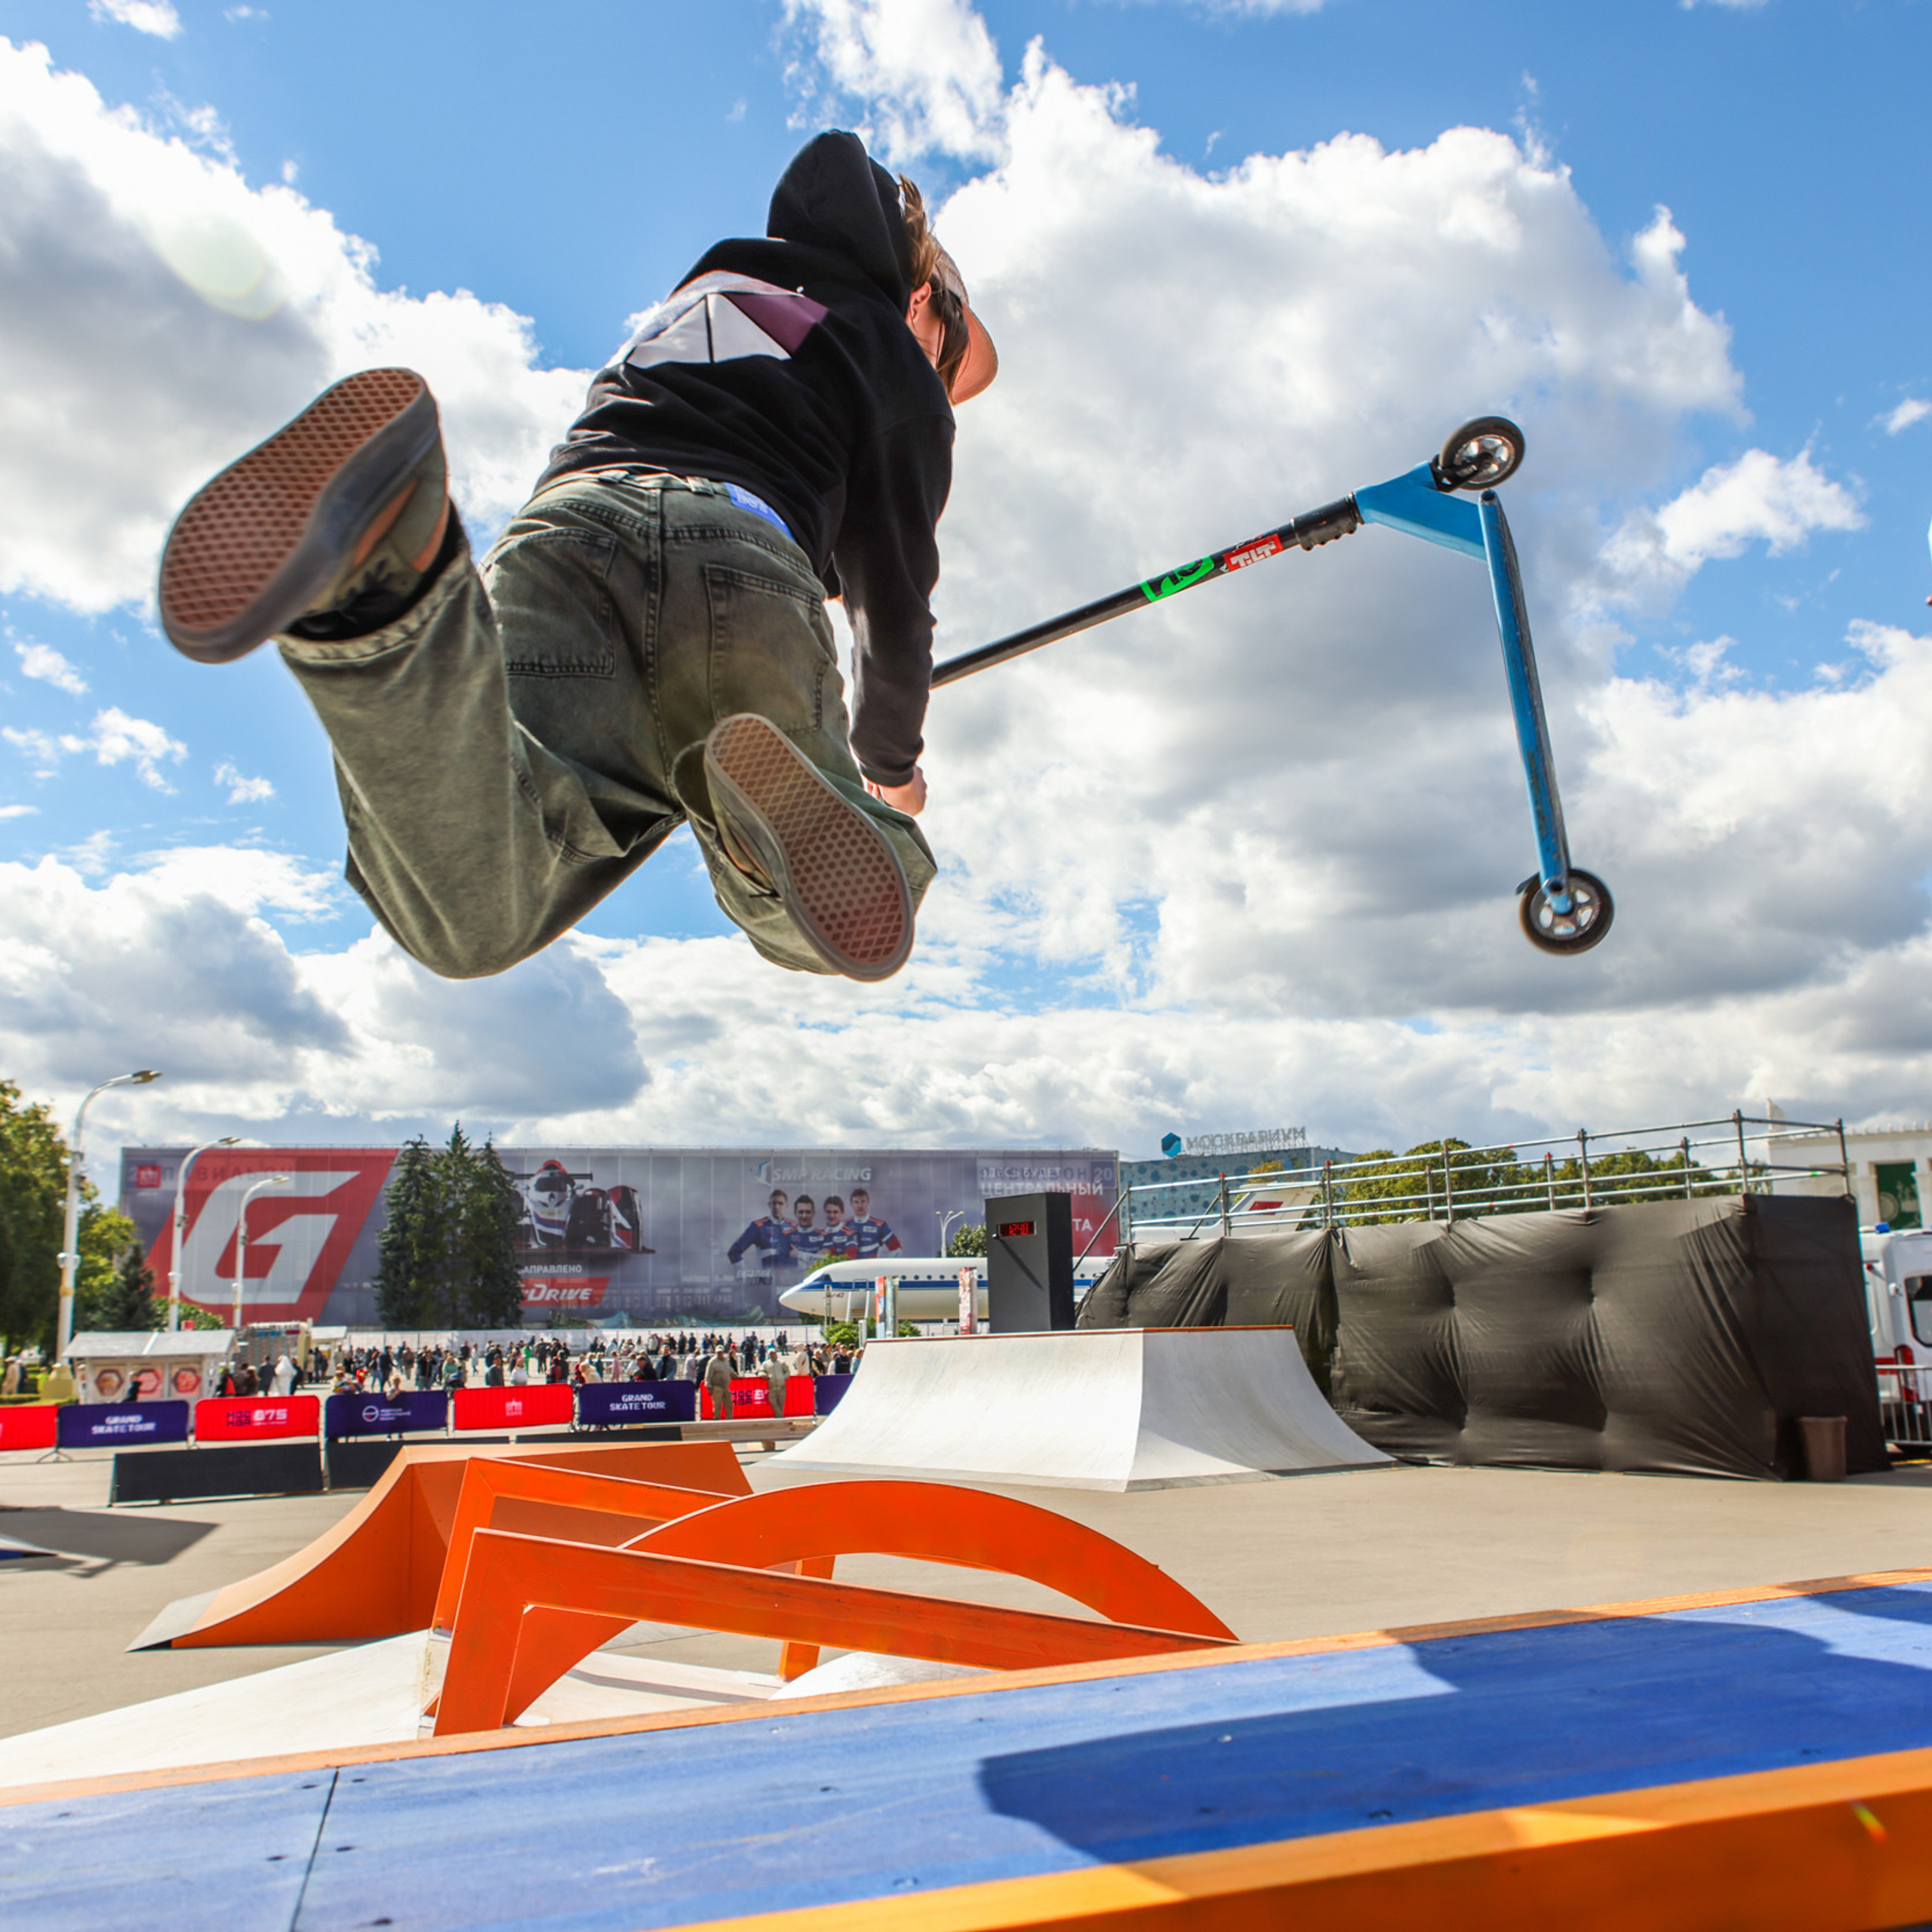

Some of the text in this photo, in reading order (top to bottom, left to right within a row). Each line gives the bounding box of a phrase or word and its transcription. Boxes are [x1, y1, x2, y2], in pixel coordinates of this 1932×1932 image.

[1186, 1126, 1306, 1151] МОСКВАРИУМ
[773, 1168, 872, 1181] SMP RACING
[1023, 1166, 1061, 1178] БУДЕТ
[981, 1179, 1104, 1196] ЦЕНТРАЛЬНЫЙ
[1072, 1218, 1094, 1232] ТА
[520, 1284, 593, 1303] -DRIVE
[622, 1394, 654, 1402] GRAND
[609, 1401, 666, 1411] SKATE TOUR
[105, 1414, 143, 1425] GRAND
[91, 1423, 157, 1435] SKATE TOUR
